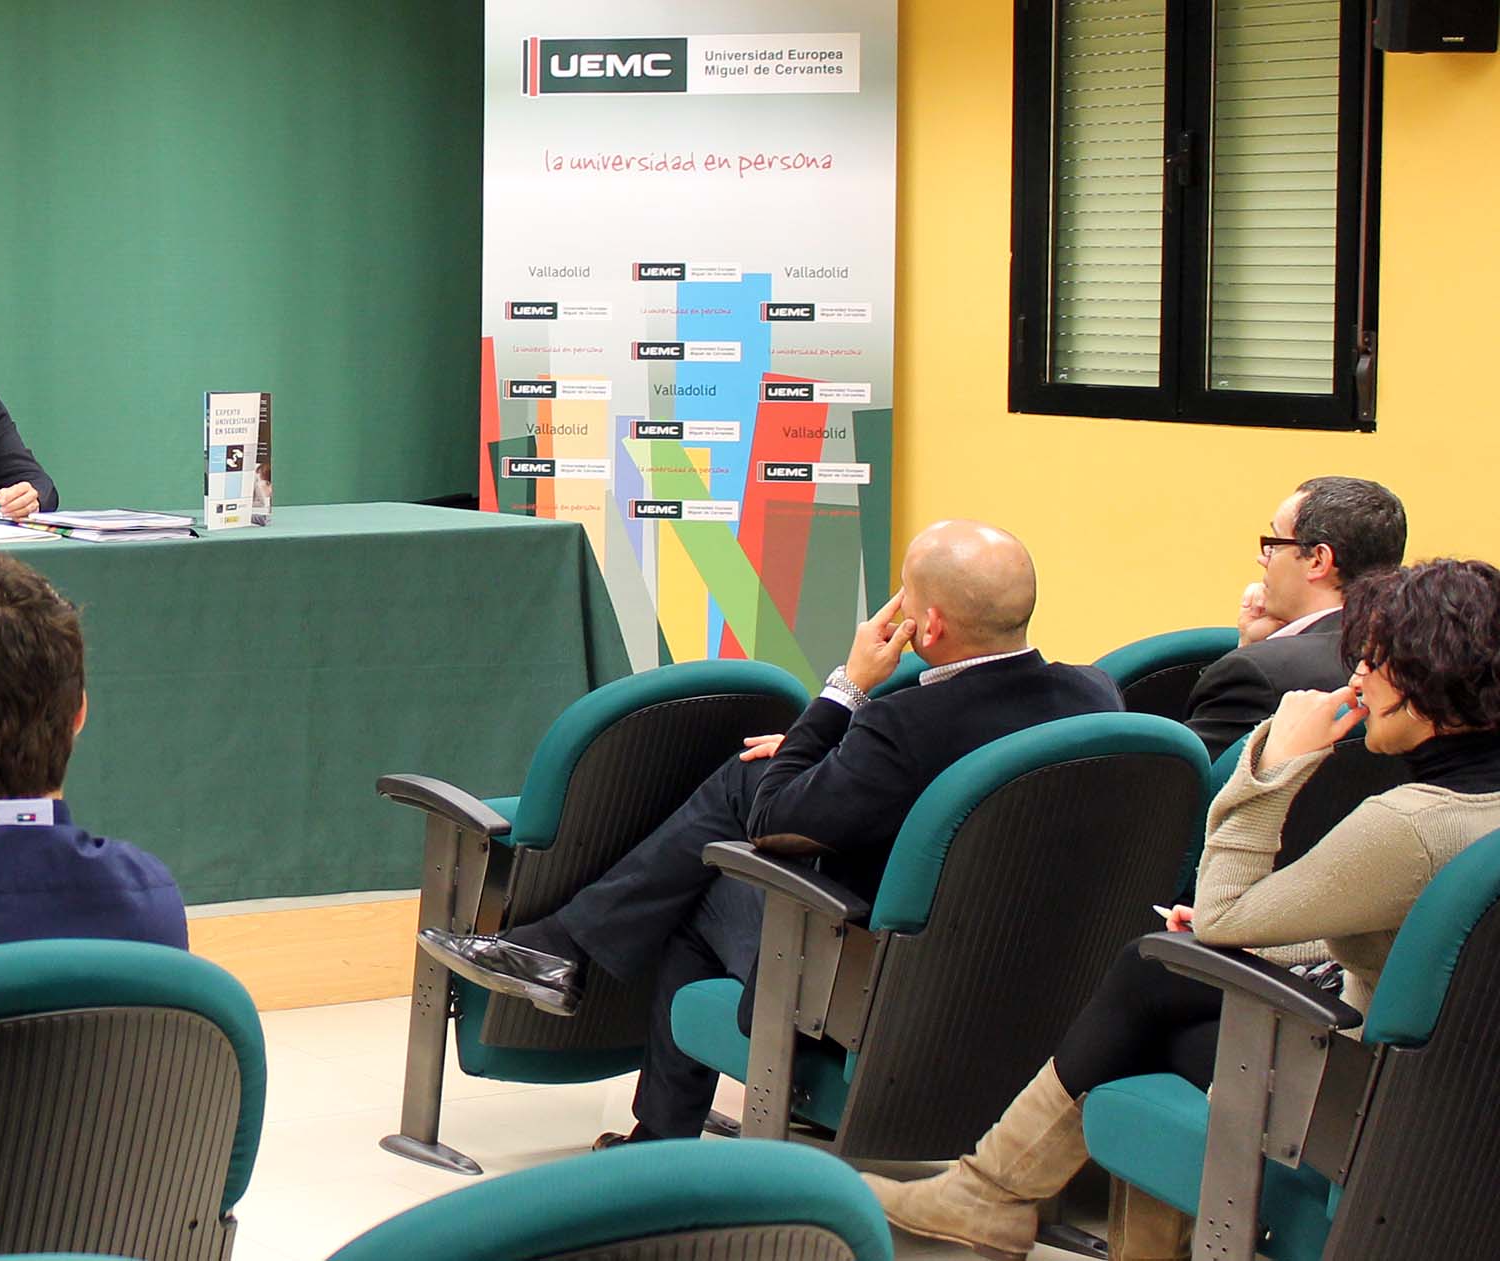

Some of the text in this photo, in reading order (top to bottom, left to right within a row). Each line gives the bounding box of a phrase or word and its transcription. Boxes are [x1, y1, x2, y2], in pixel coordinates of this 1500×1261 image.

[704, 49, 843, 62] Universidad Europea
[550, 53, 672, 78] UEMC
[704, 63, 843, 78] Miguel de Cervantes
[545, 150, 832, 178] la universidad en persona
[528, 266, 590, 278] Valladolid
[640, 267, 682, 277] UEMC
[785, 266, 849, 279] Valladolid
[513, 306, 554, 315] UEMC
[769, 307, 811, 317] UEMC
[639, 346, 680, 356] UEMC
[512, 385, 552, 394] UEMC
[653, 384, 717, 396] Valladolid
[768, 387, 809, 397] UEMC
[526, 423, 588, 435] Valladolid
[638, 425, 679, 435] UEMC
[782, 427, 846, 440] Valladolid
[511, 463, 551, 473] UEMC
[766, 467, 808, 477] UEMC
[636, 505, 678, 514] UEMC
